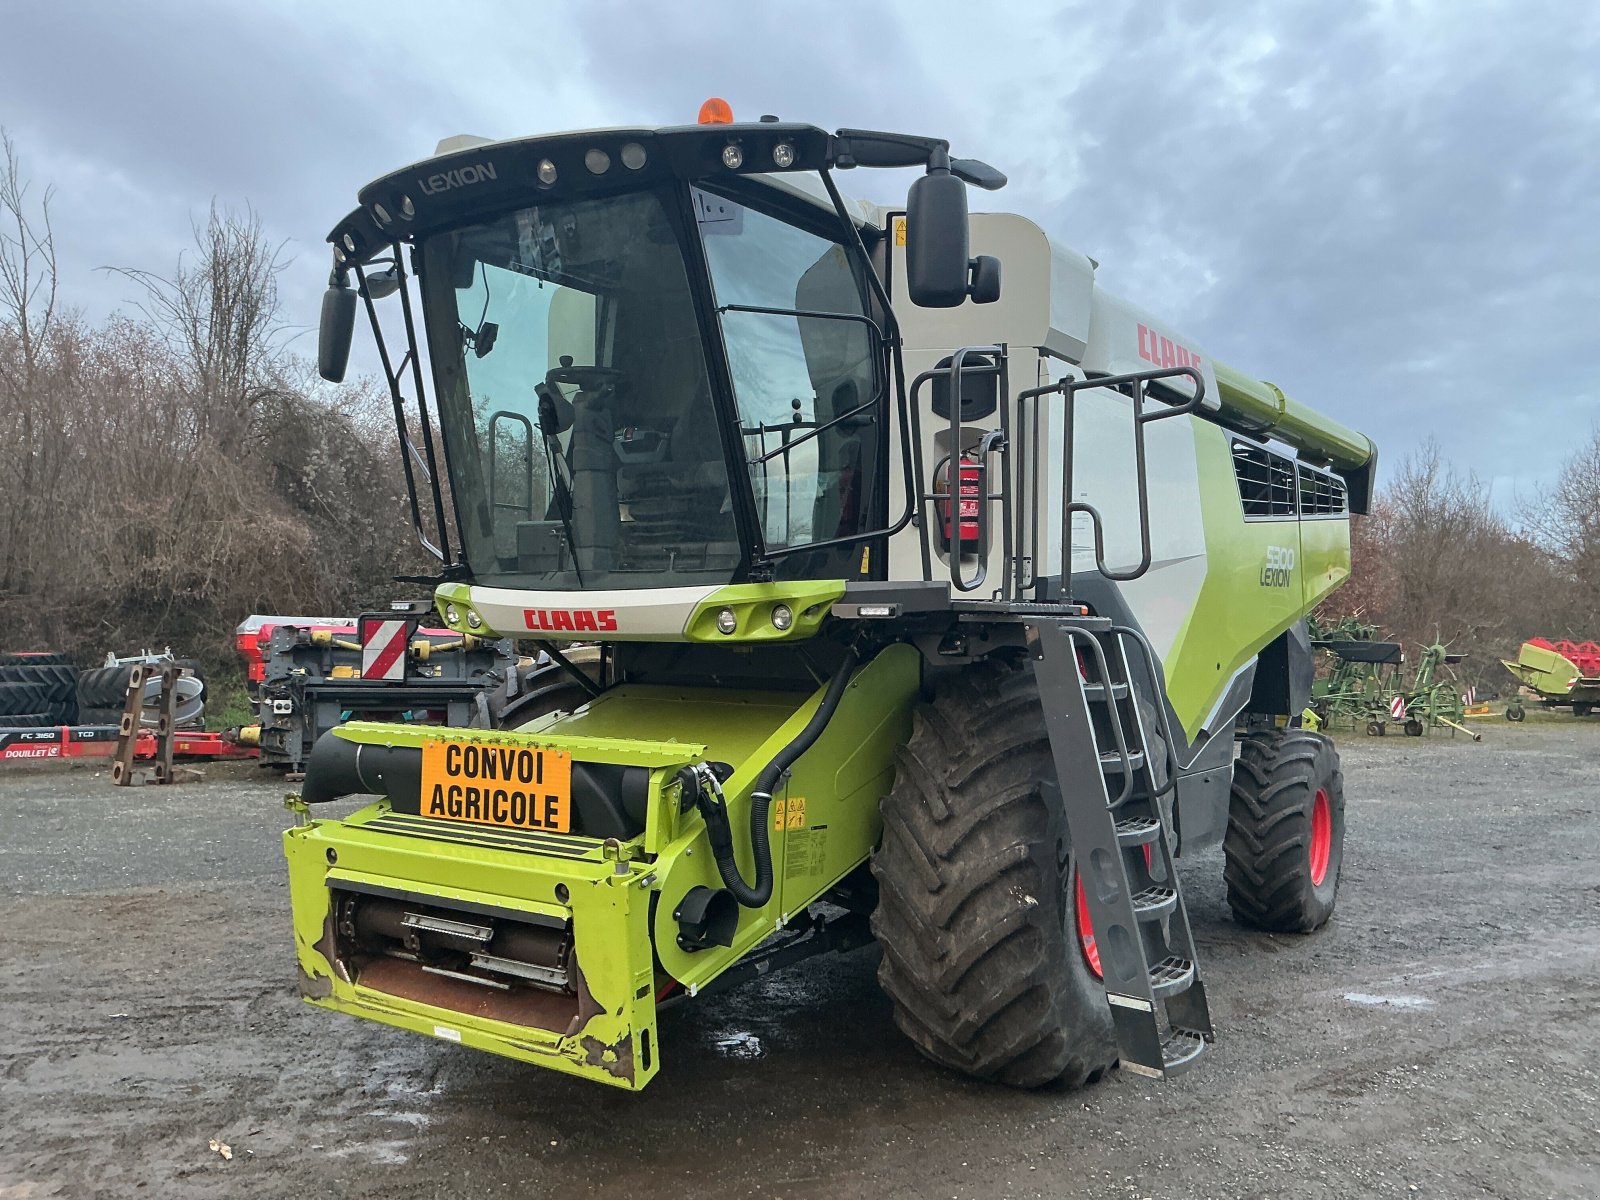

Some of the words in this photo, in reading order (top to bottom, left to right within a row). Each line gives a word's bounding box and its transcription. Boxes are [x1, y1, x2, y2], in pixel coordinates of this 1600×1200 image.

[418, 161, 498, 196] LEXION
[1260, 567, 1291, 587] LEXION
[523, 609, 618, 631] CLAAS
[5, 749, 46, 758] DOUILLET
[446, 744, 543, 784] CONVOI
[429, 783, 559, 829] AGRICOLE
